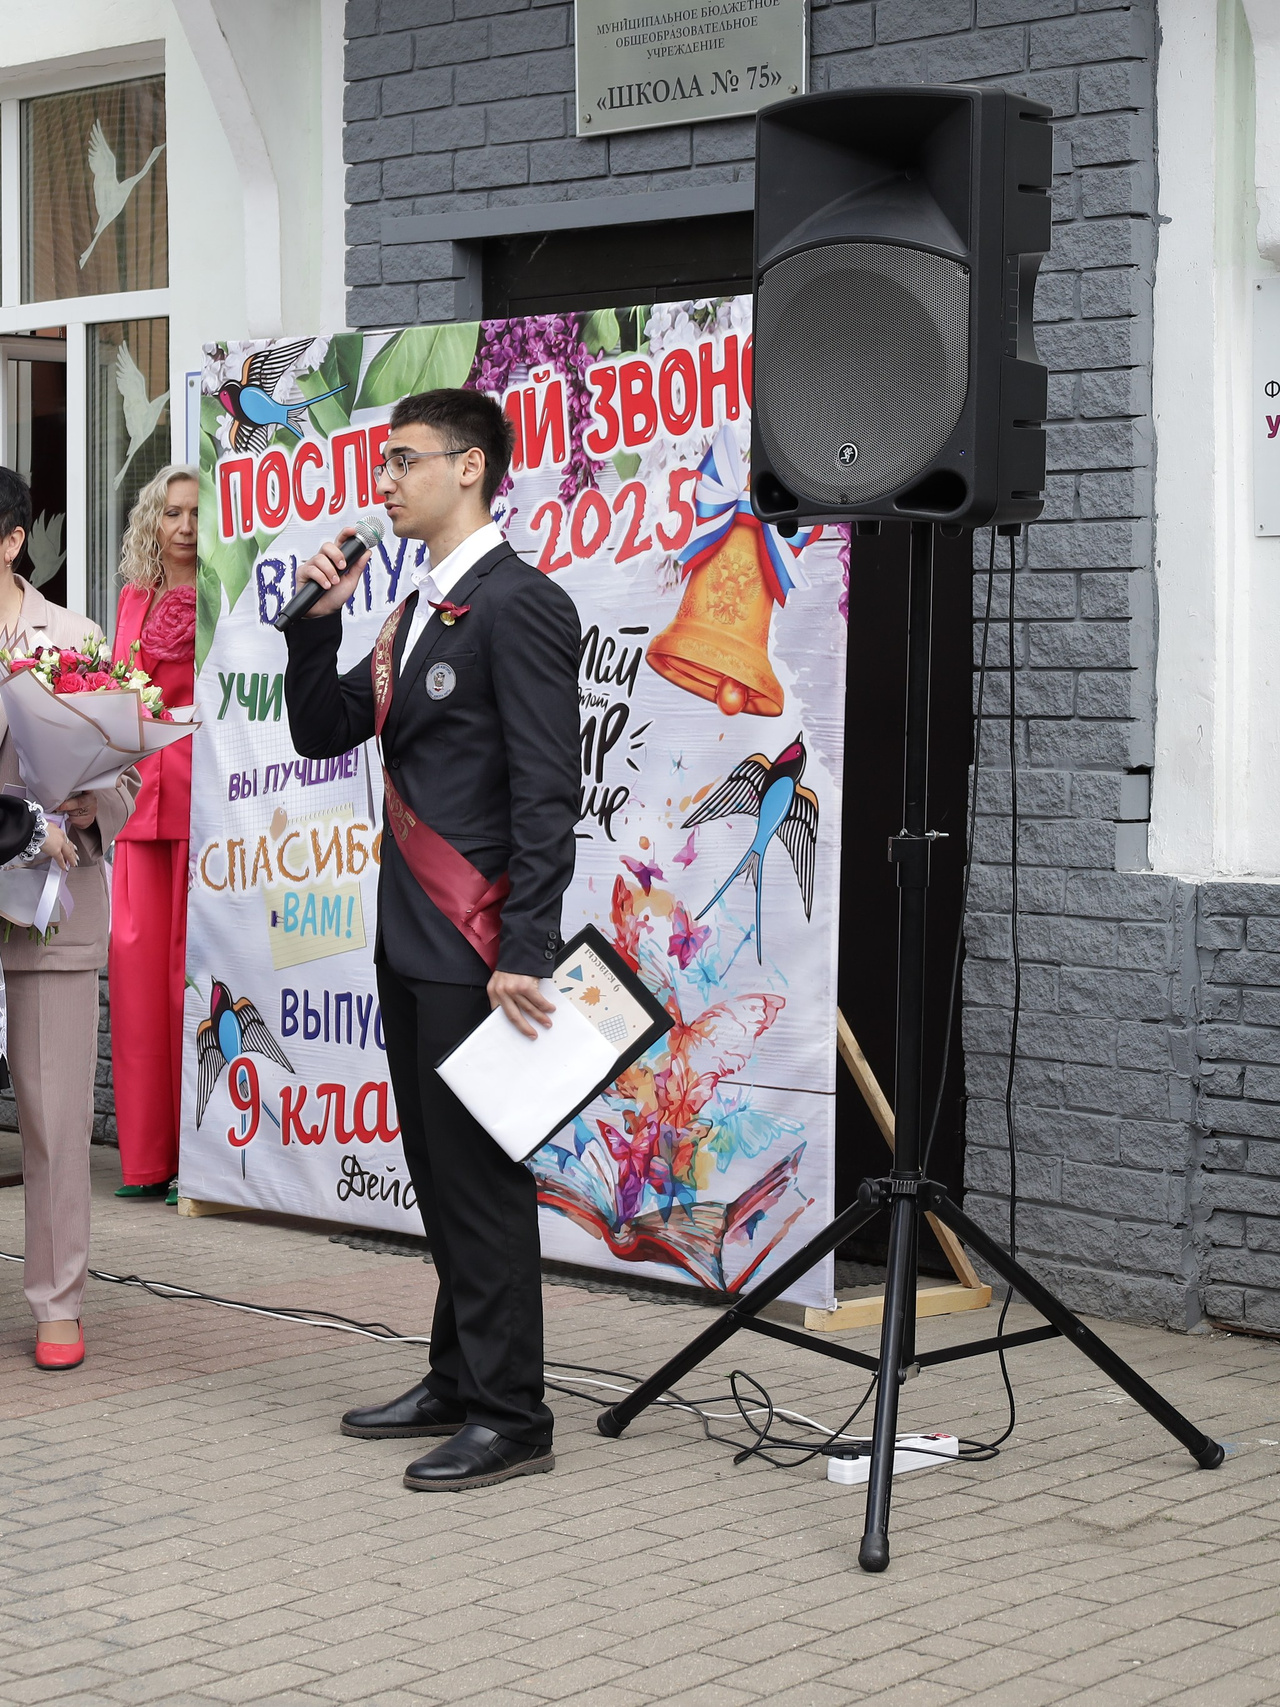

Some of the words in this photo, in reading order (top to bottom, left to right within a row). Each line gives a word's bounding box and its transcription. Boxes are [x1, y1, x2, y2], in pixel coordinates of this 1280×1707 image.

[596, 9, 698, 36] МУНИЦИПАЛЬНОЕ
[615, 16, 758, 48] ОБЩЕОБРАЗОВАТЕЛЬНОЕ
[646, 38, 725, 60] УЧРЕЖДЕНИЕ
[596, 74, 705, 111] «ШКОЛА
[710, 69, 739, 96] №
[746, 64, 782, 91] 75»
[530, 468, 703, 574] 2025
[217, 672, 284, 722] УЧИ
[228, 772, 258, 802] ВЫ
[263, 747, 359, 795] ЛУЧШИЕ!
[283, 892, 355, 939] ВАМ!
[584, 948, 616, 984] классы
[613, 983, 623, 993] 9
[227, 1057, 261, 1147] 9
[279, 1080, 401, 1146] кла
